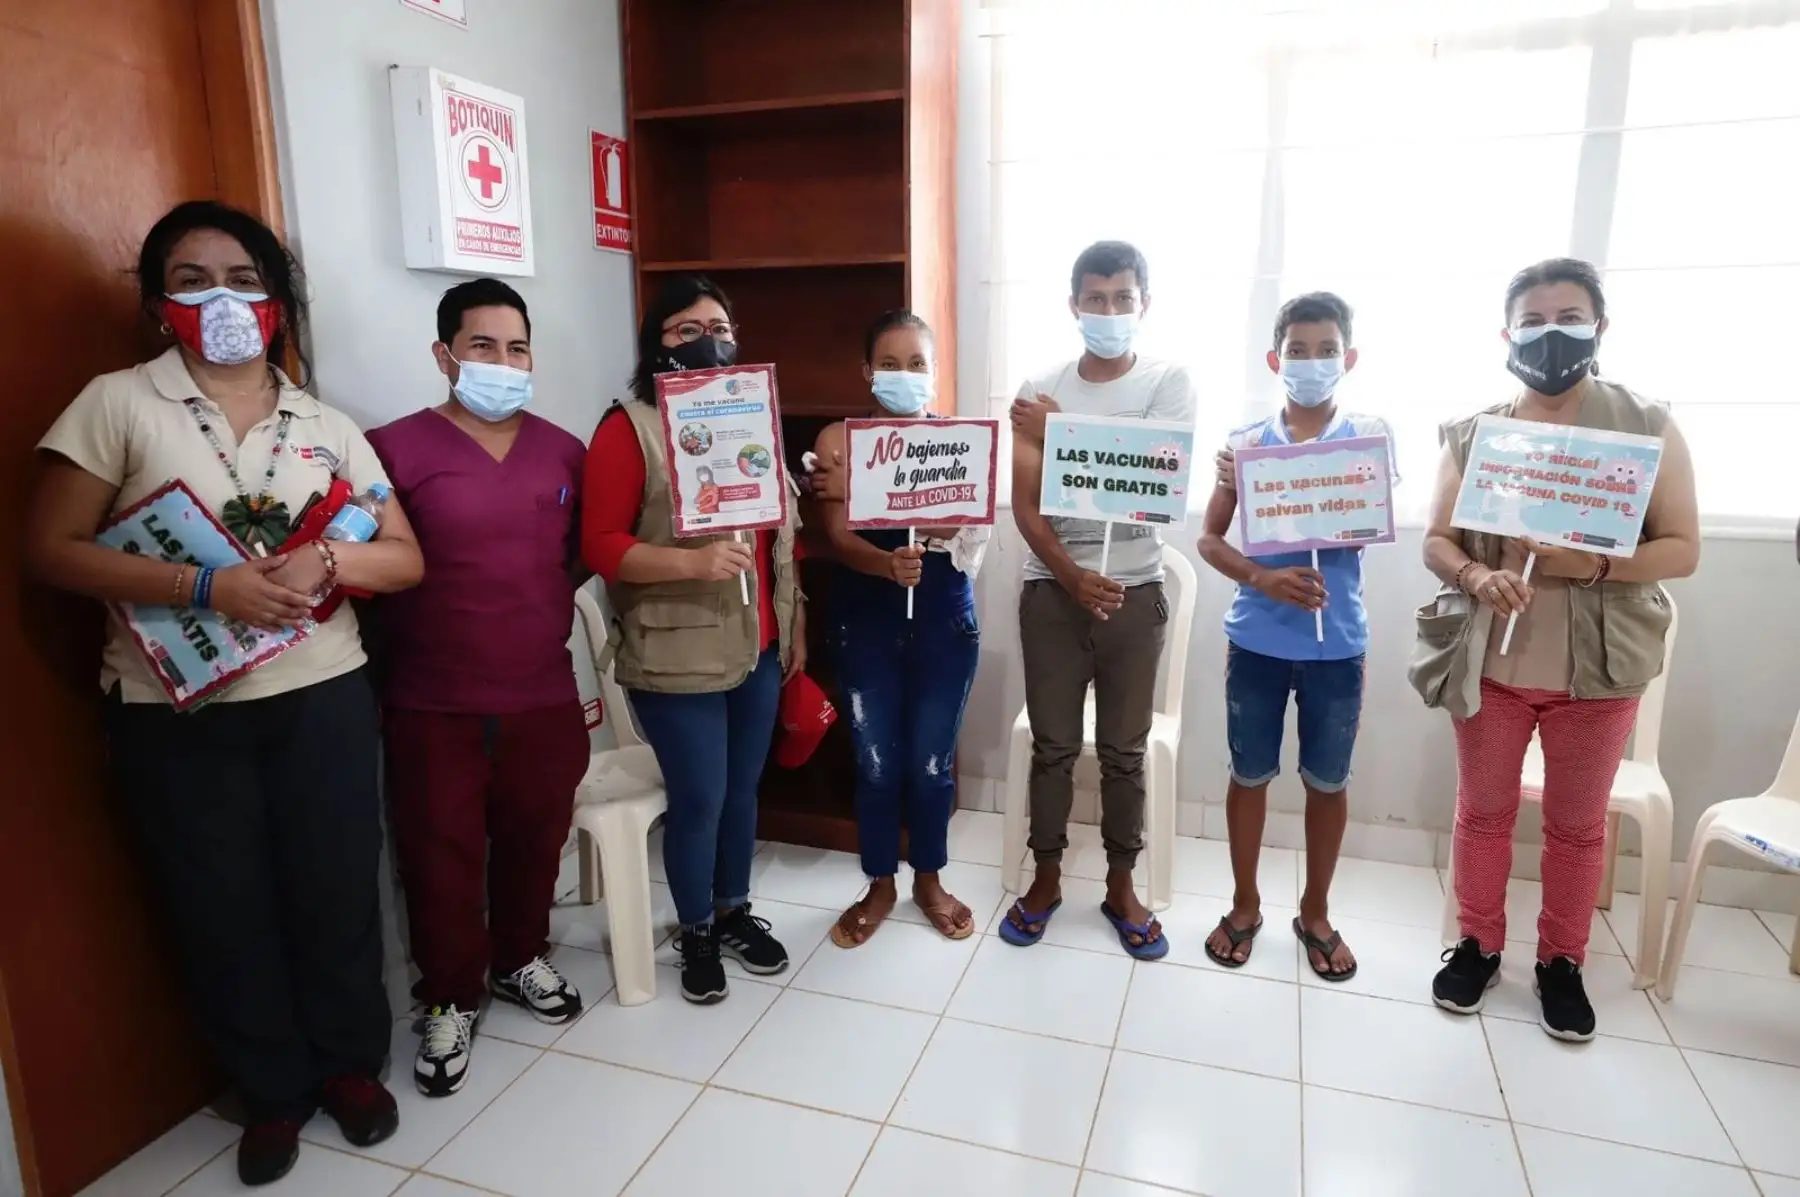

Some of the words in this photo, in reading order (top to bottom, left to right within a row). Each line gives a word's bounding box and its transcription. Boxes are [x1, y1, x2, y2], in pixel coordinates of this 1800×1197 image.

[447, 96, 514, 153] BOTIQUIN
[457, 221, 490, 240] PRIMEROS
[491, 225, 521, 245] AUXILIOS
[866, 430, 905, 470] NO
[906, 439, 970, 465] bajemos
[1056, 447, 1089, 463] LAS
[1093, 451, 1179, 471] VACUNAS
[893, 465, 905, 487] la
[909, 458, 967, 491] guardia
[1062, 474, 1098, 489] SON
[1103, 478, 1168, 497] GRATIS
[1253, 480, 1285, 493] Las
[1290, 474, 1365, 490] vacunas
[1584, 477, 1637, 495] SOBRE
[891, 497, 913, 508] ANTE
[915, 494, 927, 505] LA
[928, 486, 972, 504] COVID-19
[1475, 477, 1493, 489] LA
[1560, 492, 1608, 509] COVID
[1612, 501, 1632, 513] 19
[1255, 502, 1313, 518] salvan
[1319, 498, 1367, 513] vidas
[141, 513, 184, 555] LAS
